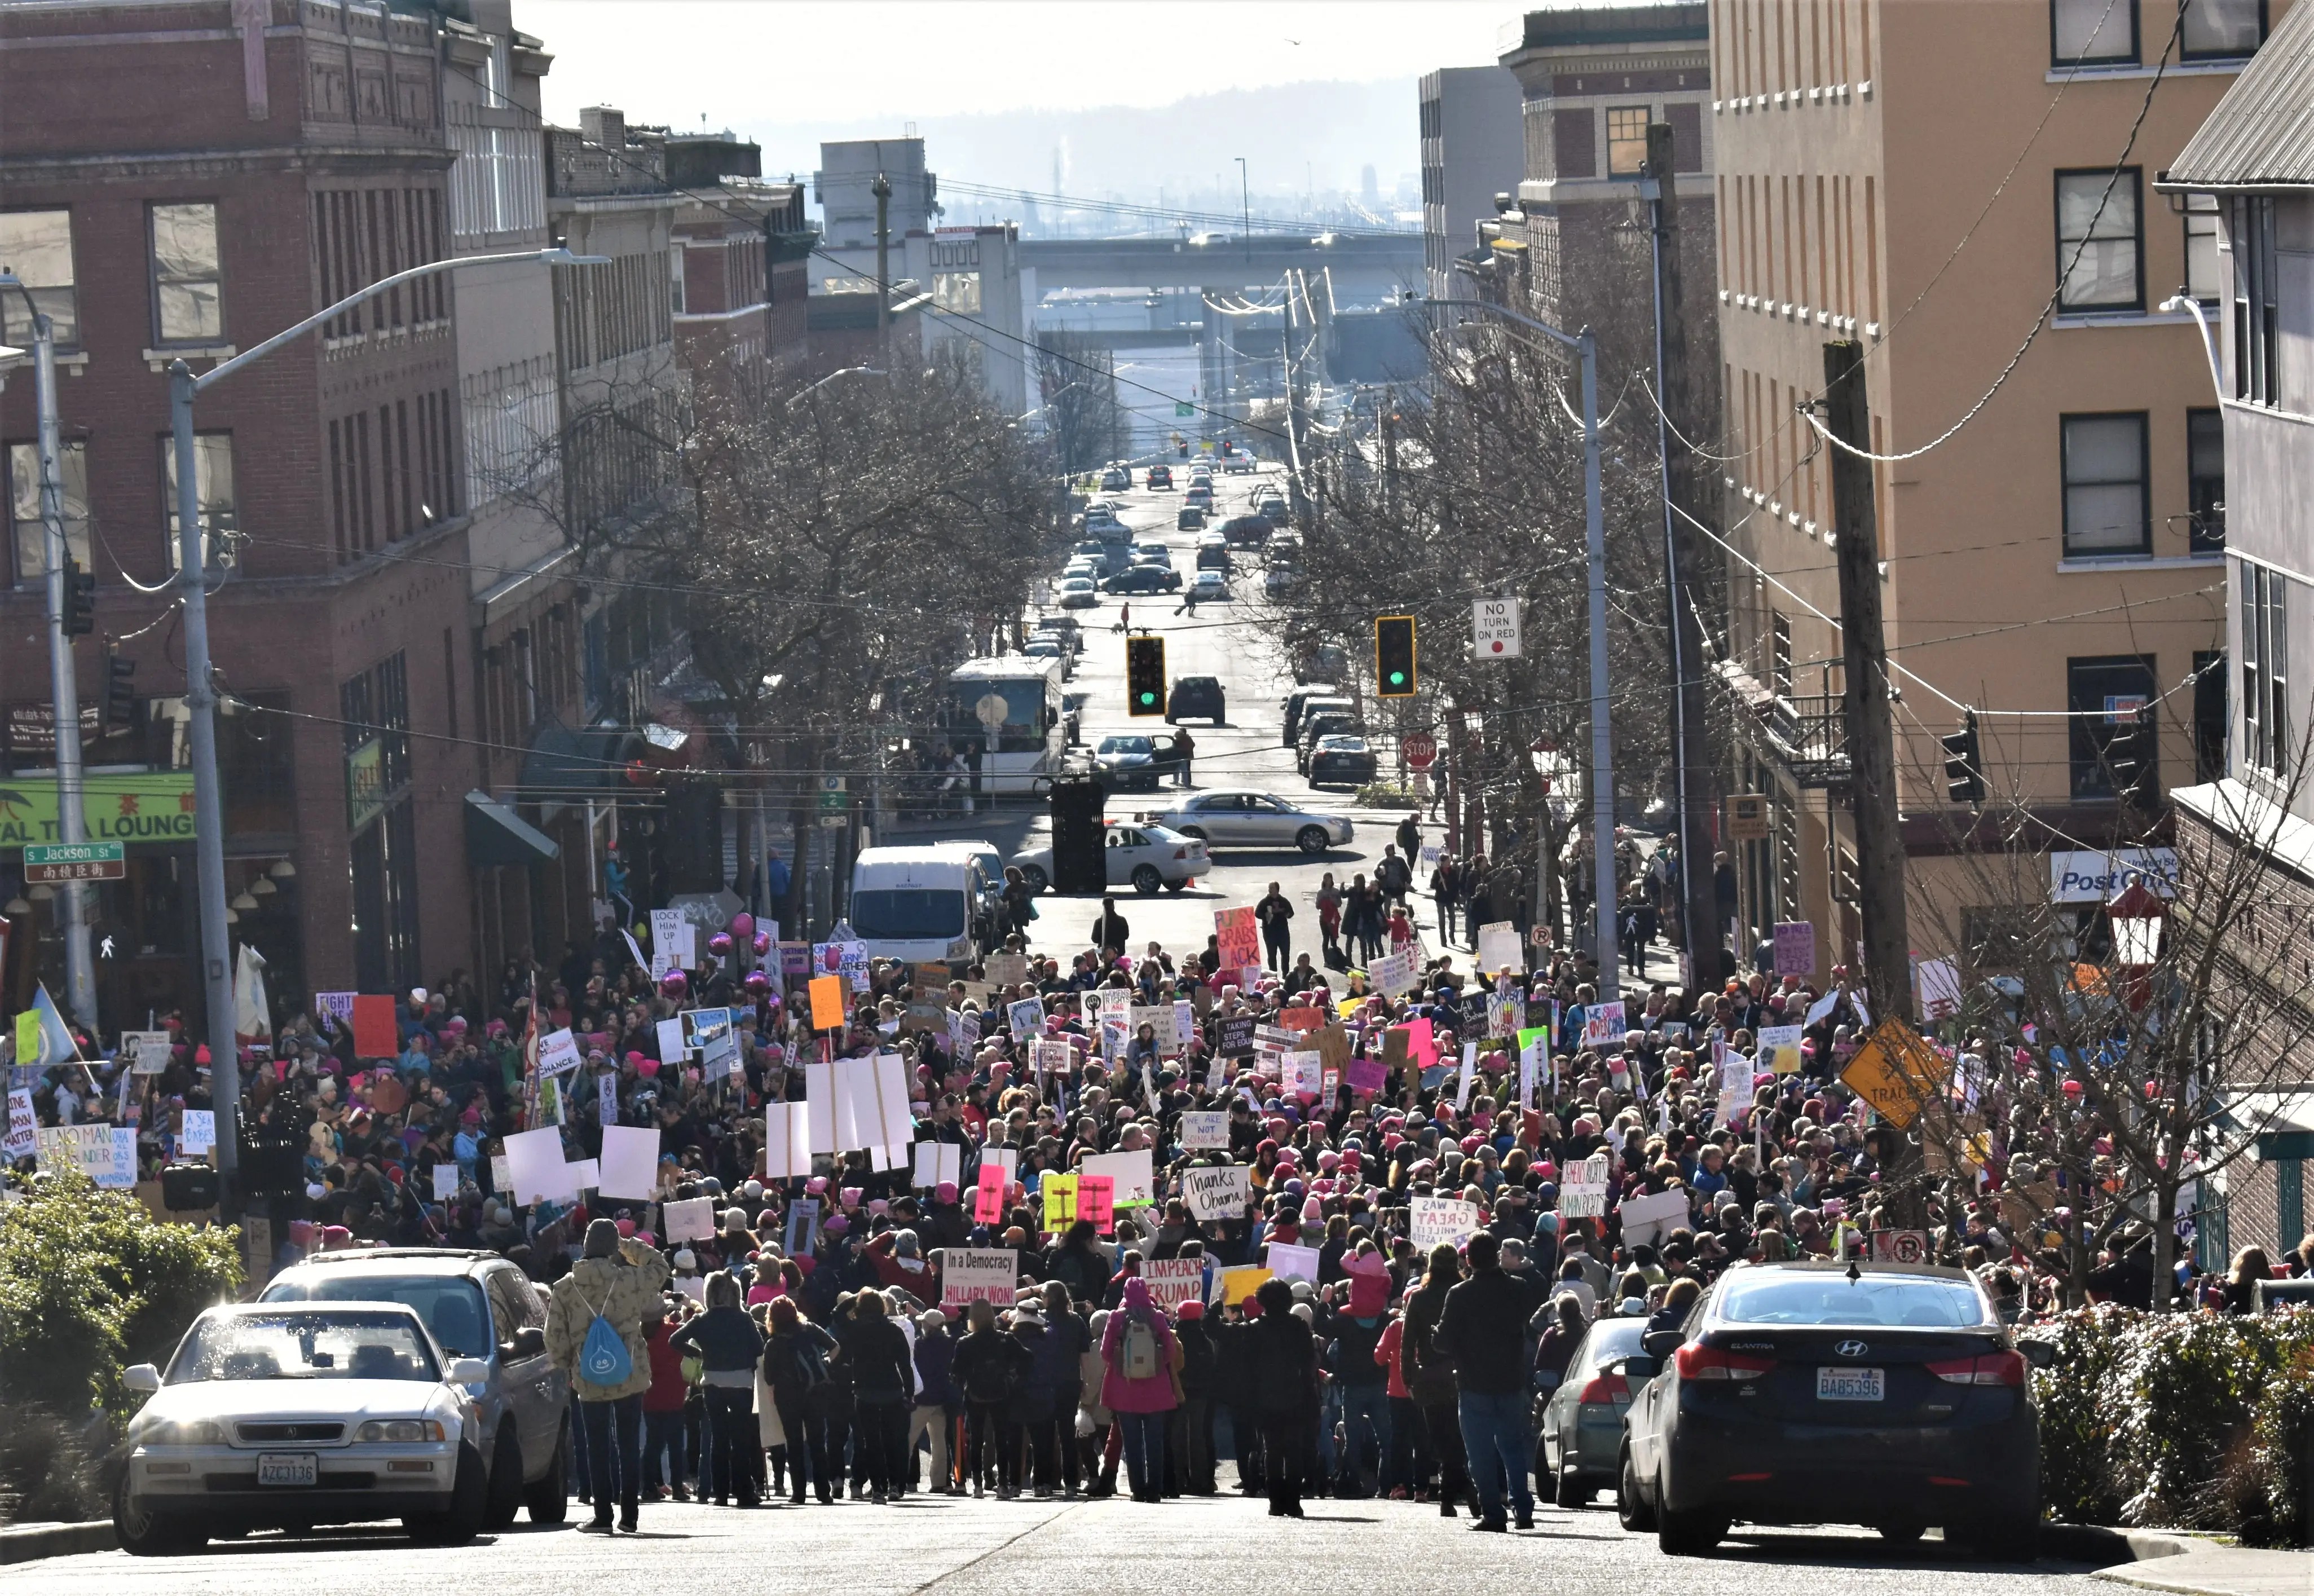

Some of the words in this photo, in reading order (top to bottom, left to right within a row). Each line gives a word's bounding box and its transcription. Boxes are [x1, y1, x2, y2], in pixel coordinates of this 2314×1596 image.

[1486, 604, 1505, 614] NO
[1478, 631, 1492, 639] ON
[1497, 629, 1515, 638] RED
[1404, 740, 1434, 755] STOP
[28, 852, 35, 861] S
[43, 845, 91, 861] Jackson
[99, 847, 109, 858] St
[2061, 871, 2117, 891] Post
[655, 911, 679, 920] LOCK
[664, 932, 675, 940] UP
[1218, 926, 1259, 948] GRABS
[1221, 945, 1260, 967] ACK
[1448, 999, 1473, 1013] Well
[1587, 1007, 1601, 1019] WE
[1109, 1020, 1127, 1031] OVE
[1226, 1020, 1251, 1031] TAKING
[1223, 1030, 1245, 1041] STEPS
[1222, 1041, 1236, 1050] FOR
[186, 1115, 193, 1125] A
[1185, 1116, 1198, 1125] WE
[1205, 1114, 1222, 1123] ARE
[55, 1128, 80, 1147] NO
[82, 1126, 113, 1144] MAN
[1197, 1125, 1215, 1134] NOT
[5, 1128, 34, 1147] MATTER
[1184, 1134, 1207, 1144] GOING
[1184, 1167, 1235, 1194] Thanks
[948, 1251, 956, 1268] In
[958, 1255, 963, 1268] a
[966, 1251, 1013, 1273] Democracy
[1145, 1258, 1202, 1278] IMPEACH
[945, 1284, 986, 1303] HILLARY
[988, 1285, 1013, 1304] WON!
[1147, 1280, 1202, 1306] TRUMP
[1821, 1378, 1880, 1396] BAB5396
[261, 1466, 313, 1480] AZC3136
